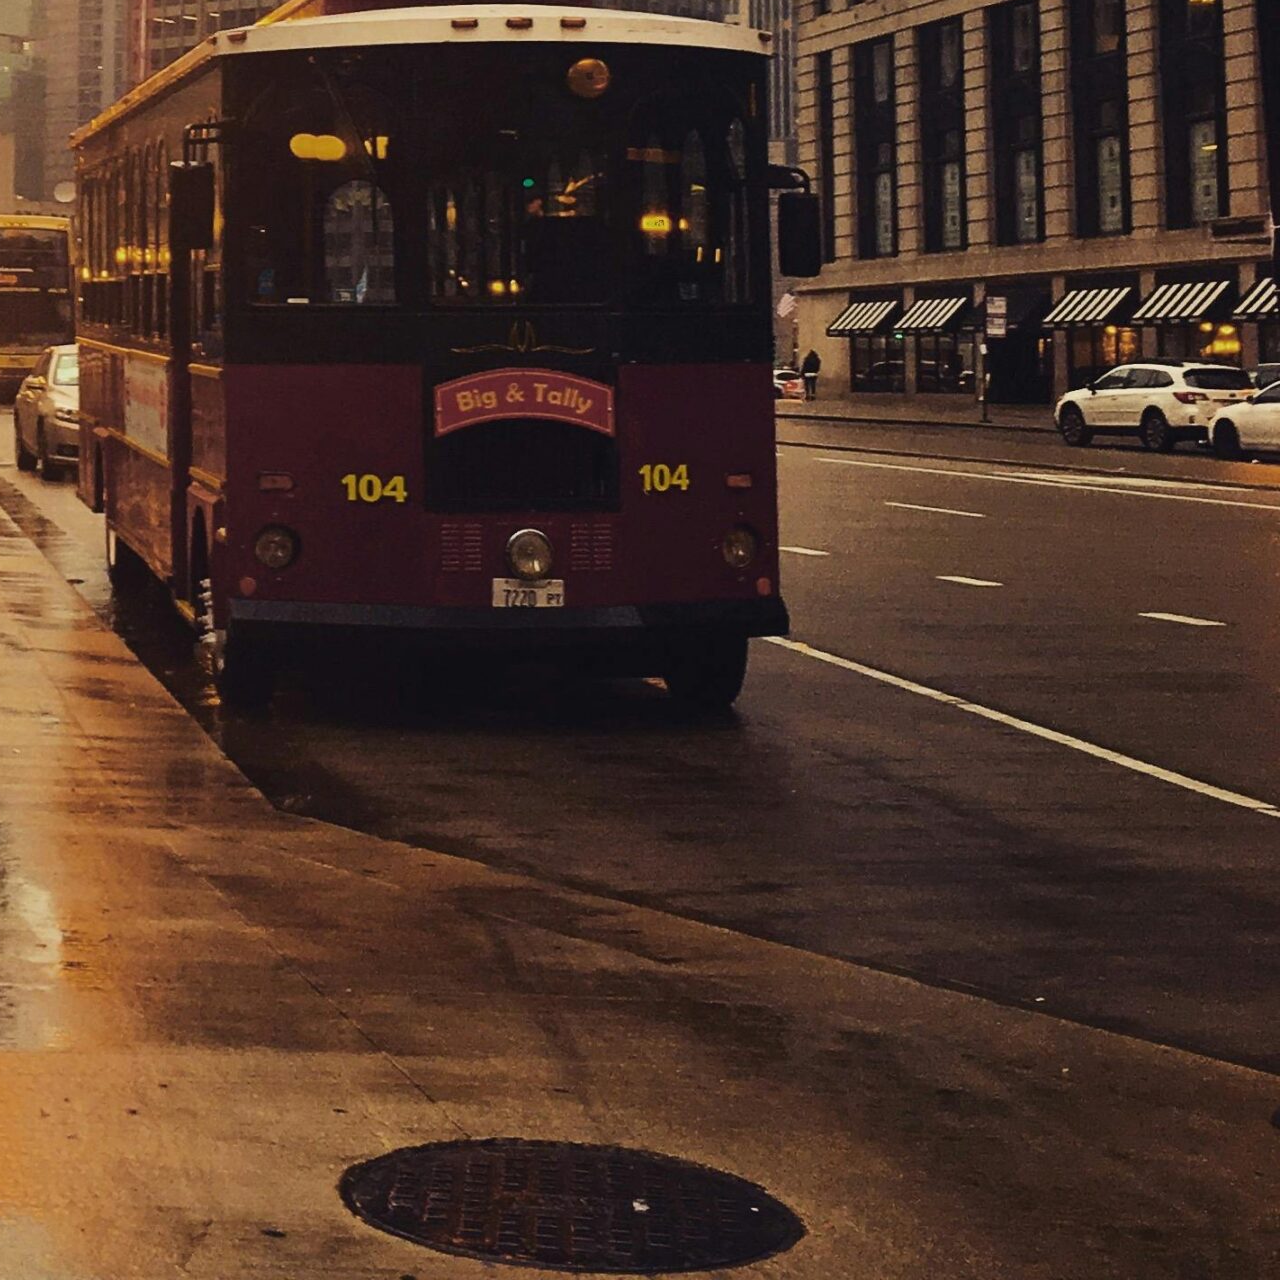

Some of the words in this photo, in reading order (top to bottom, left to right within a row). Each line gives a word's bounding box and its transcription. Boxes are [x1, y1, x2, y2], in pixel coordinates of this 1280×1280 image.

[455, 389, 498, 412] Big
[505, 382, 525, 403] &
[533, 382, 593, 414] Tally
[340, 473, 407, 503] 104
[638, 463, 690, 492] 104
